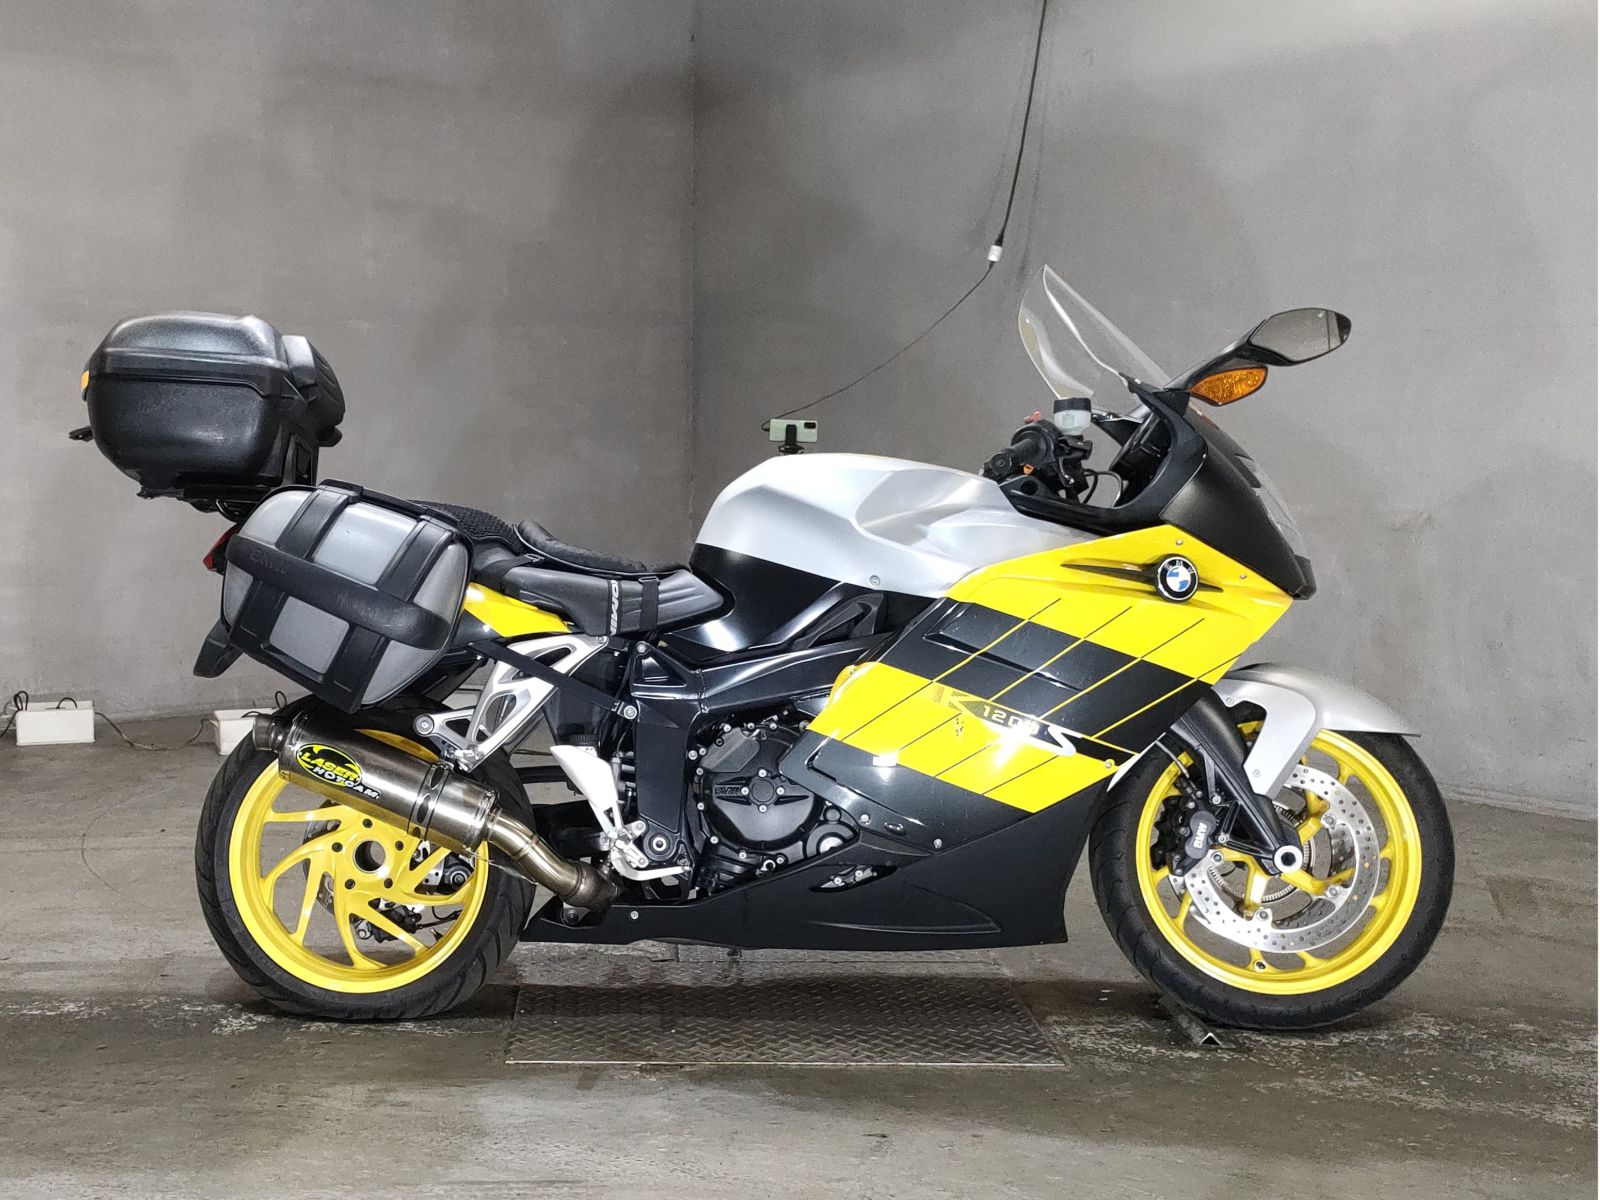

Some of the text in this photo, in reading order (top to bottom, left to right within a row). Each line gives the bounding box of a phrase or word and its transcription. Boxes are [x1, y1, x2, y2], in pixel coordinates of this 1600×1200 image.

[1163, 560, 1195, 574] BMW
[300, 751, 360, 781] LASER
[1192, 822, 1208, 849] BMW
